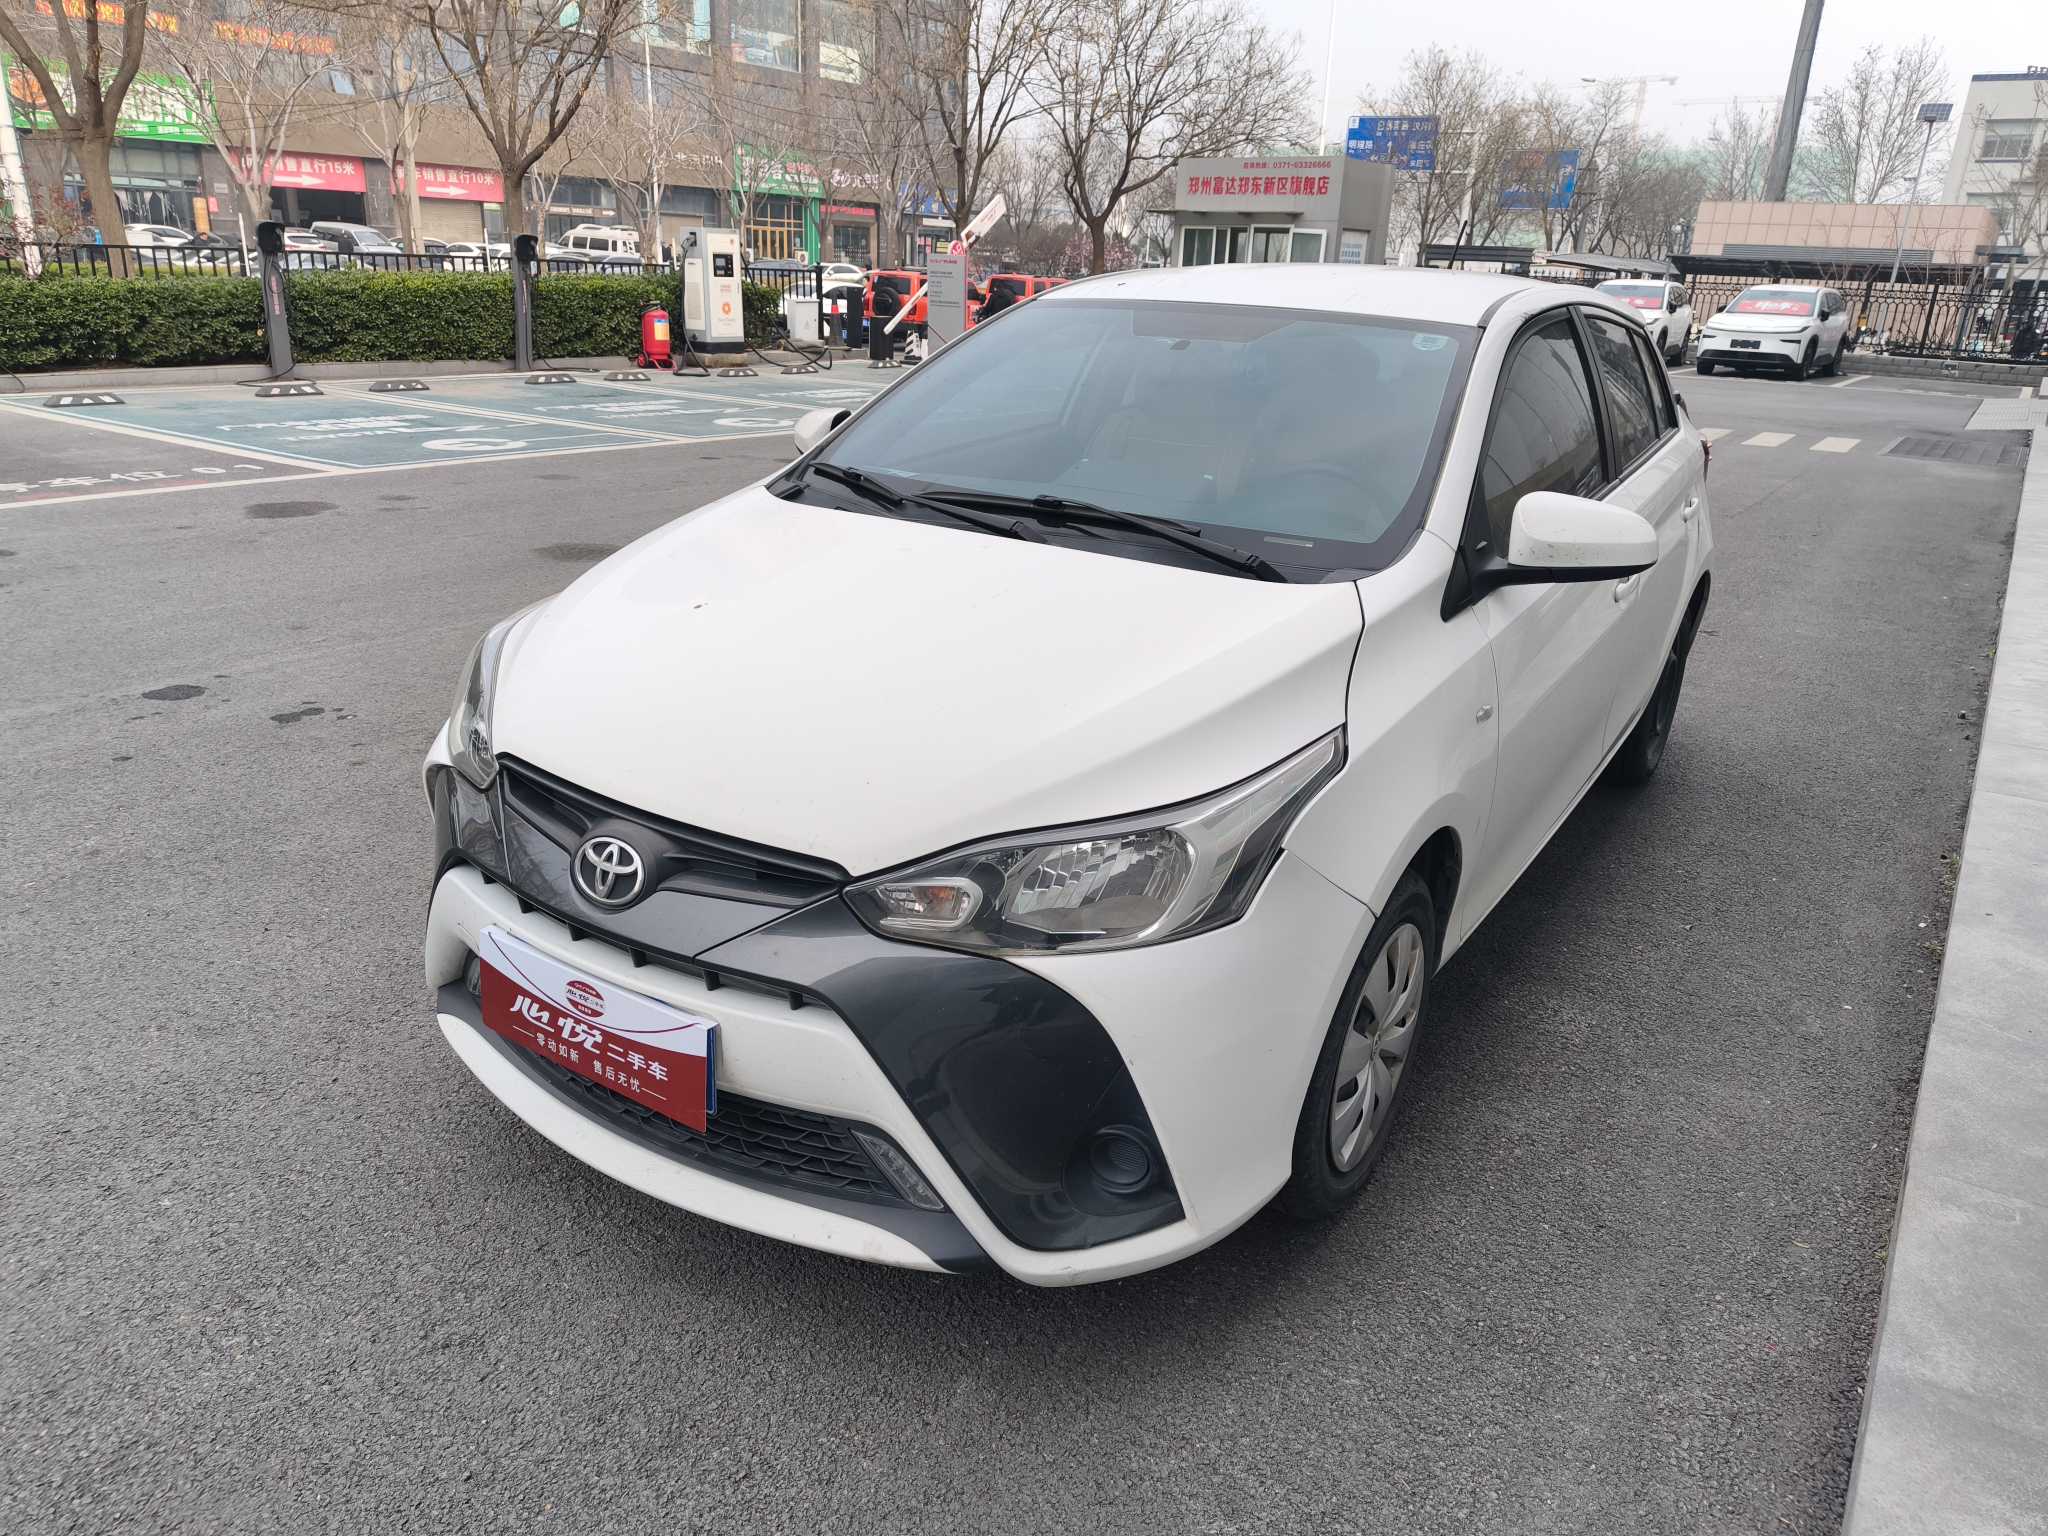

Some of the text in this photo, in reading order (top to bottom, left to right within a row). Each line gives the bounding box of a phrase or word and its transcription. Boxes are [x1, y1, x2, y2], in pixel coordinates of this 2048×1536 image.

[242, 155, 355, 175] 销售直行15米
[1188, 176, 1330, 196] 郑州富达郑东新区旗舰店
[593, 1060, 641, 1093] 售后无忧
